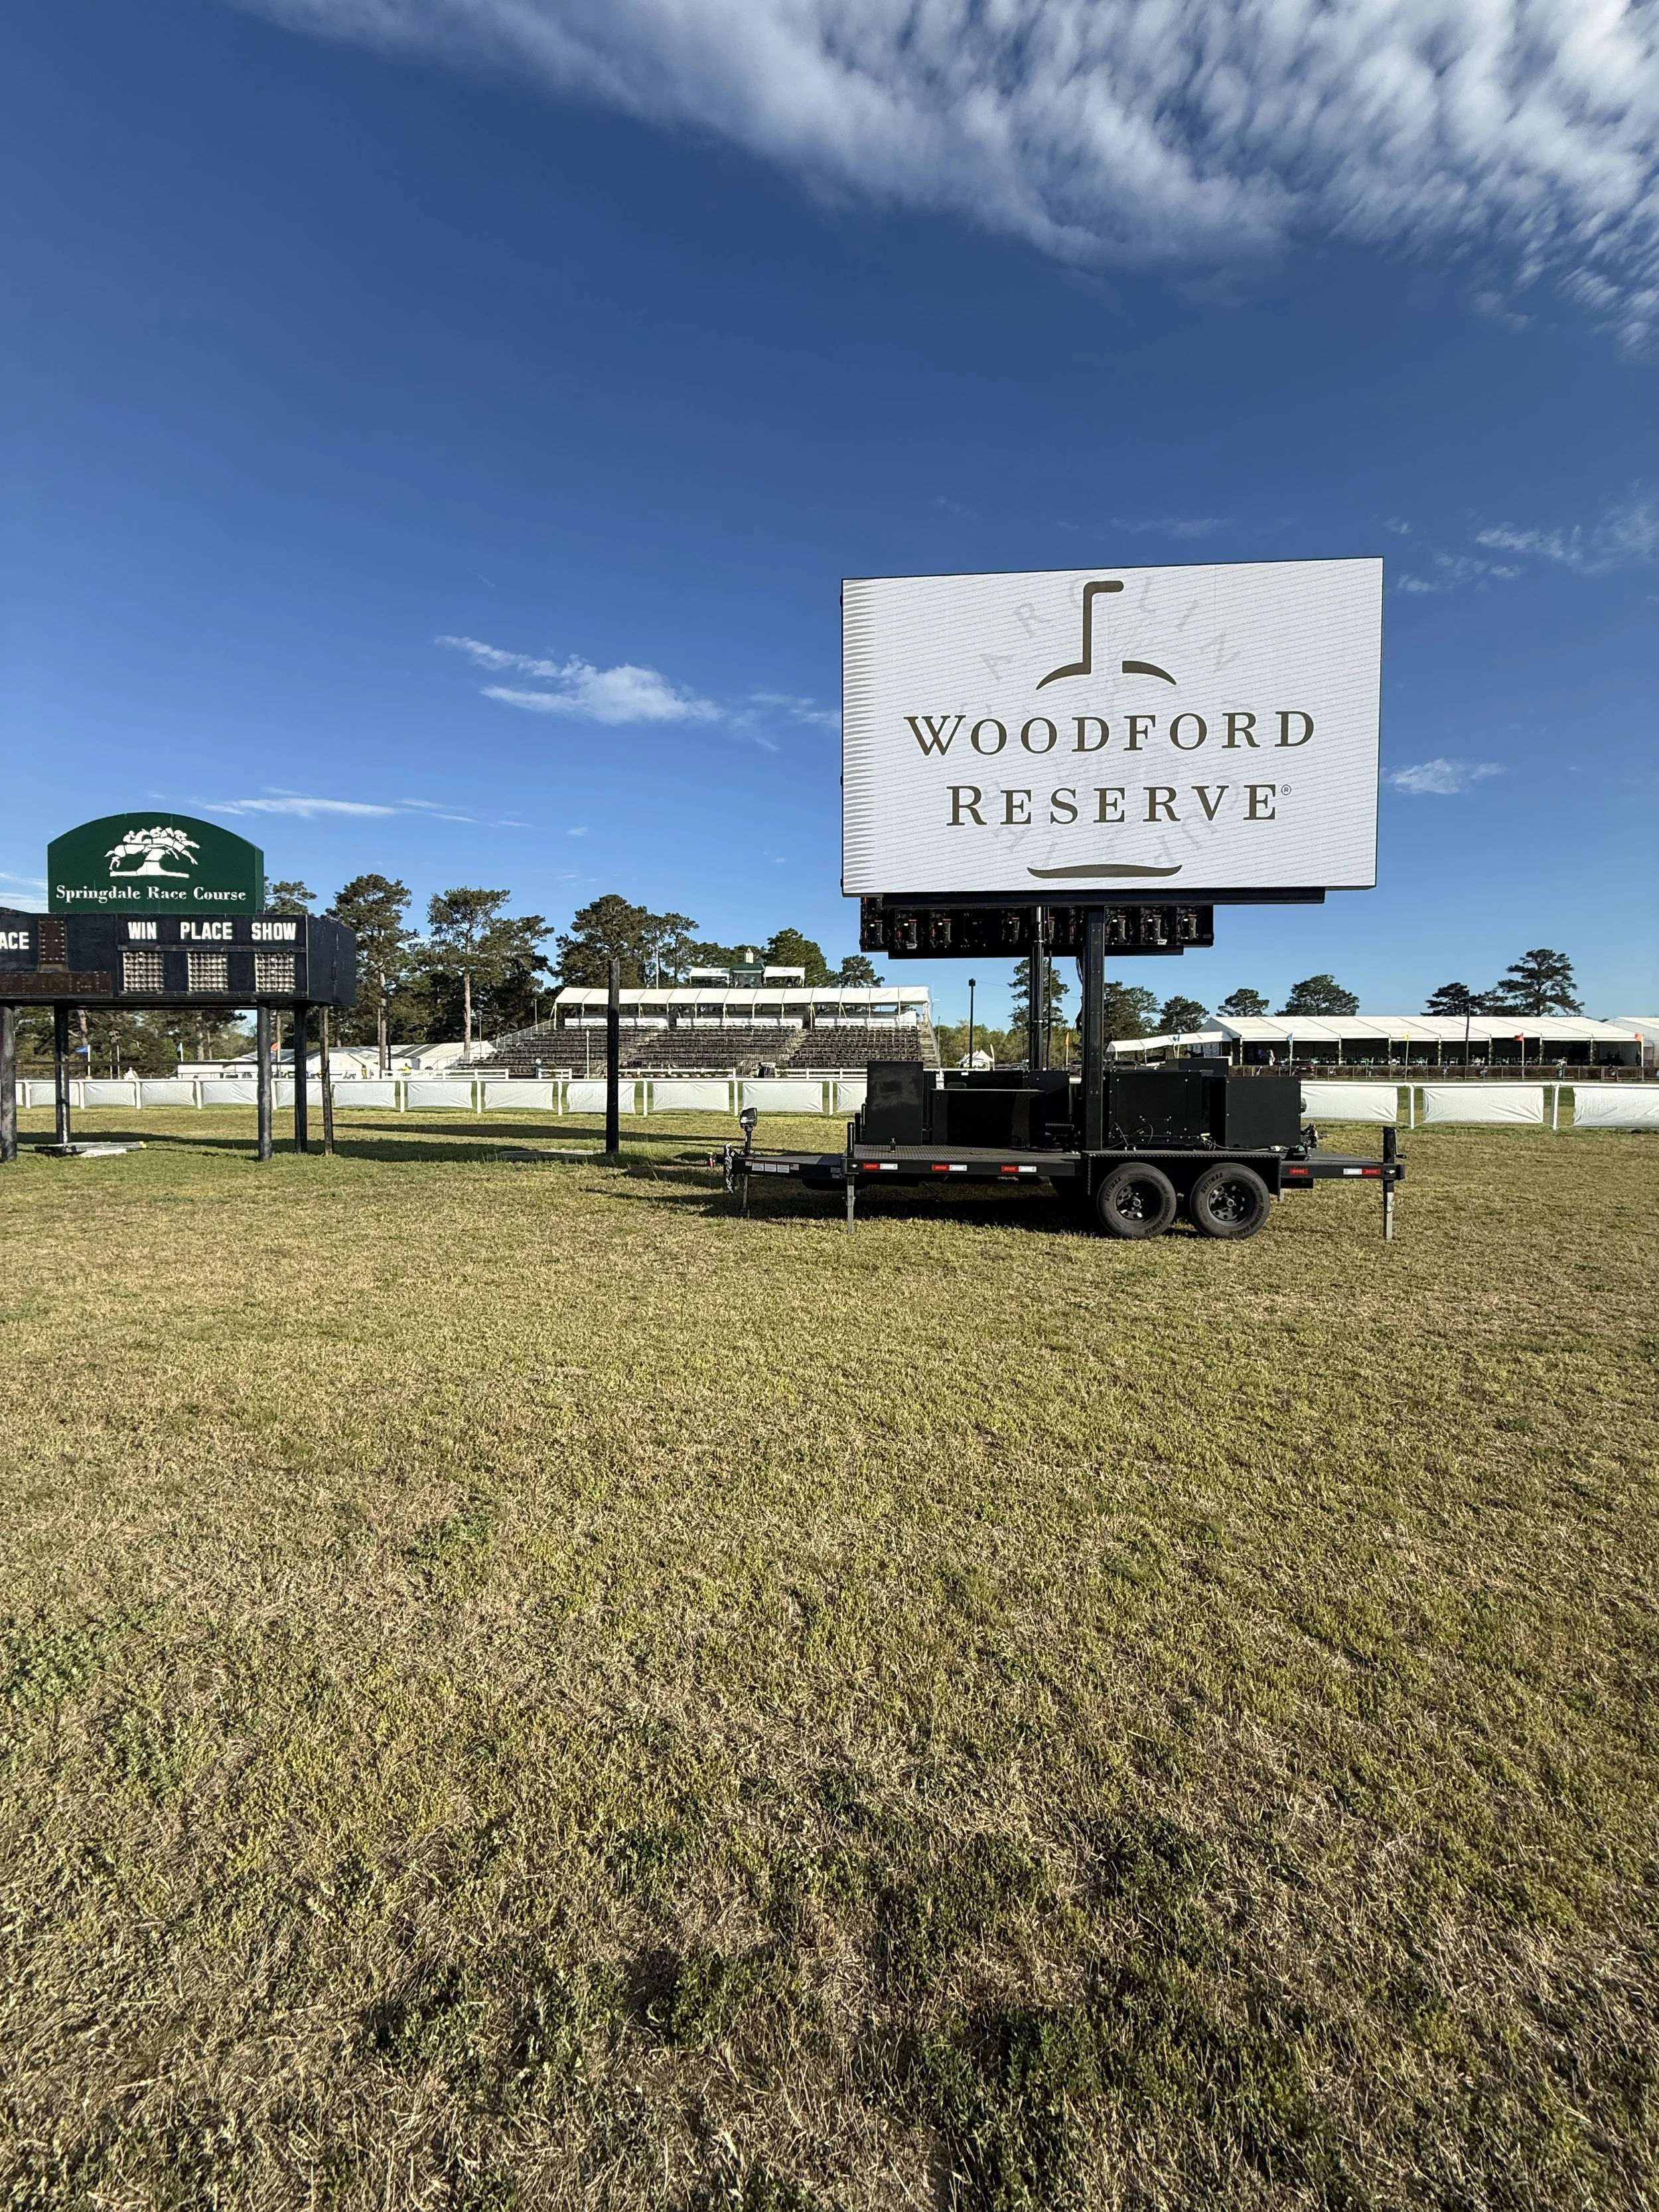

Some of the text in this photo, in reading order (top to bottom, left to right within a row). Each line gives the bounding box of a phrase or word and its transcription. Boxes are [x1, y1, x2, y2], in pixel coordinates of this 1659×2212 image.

[903, 711, 1314, 756] WOODFORD
[56, 885, 246, 903] Springdale Race Course
[127, 921, 157, 940] WIN
[180, 921, 233, 940] PLACE
[251, 922, 297, 940] SHOW
